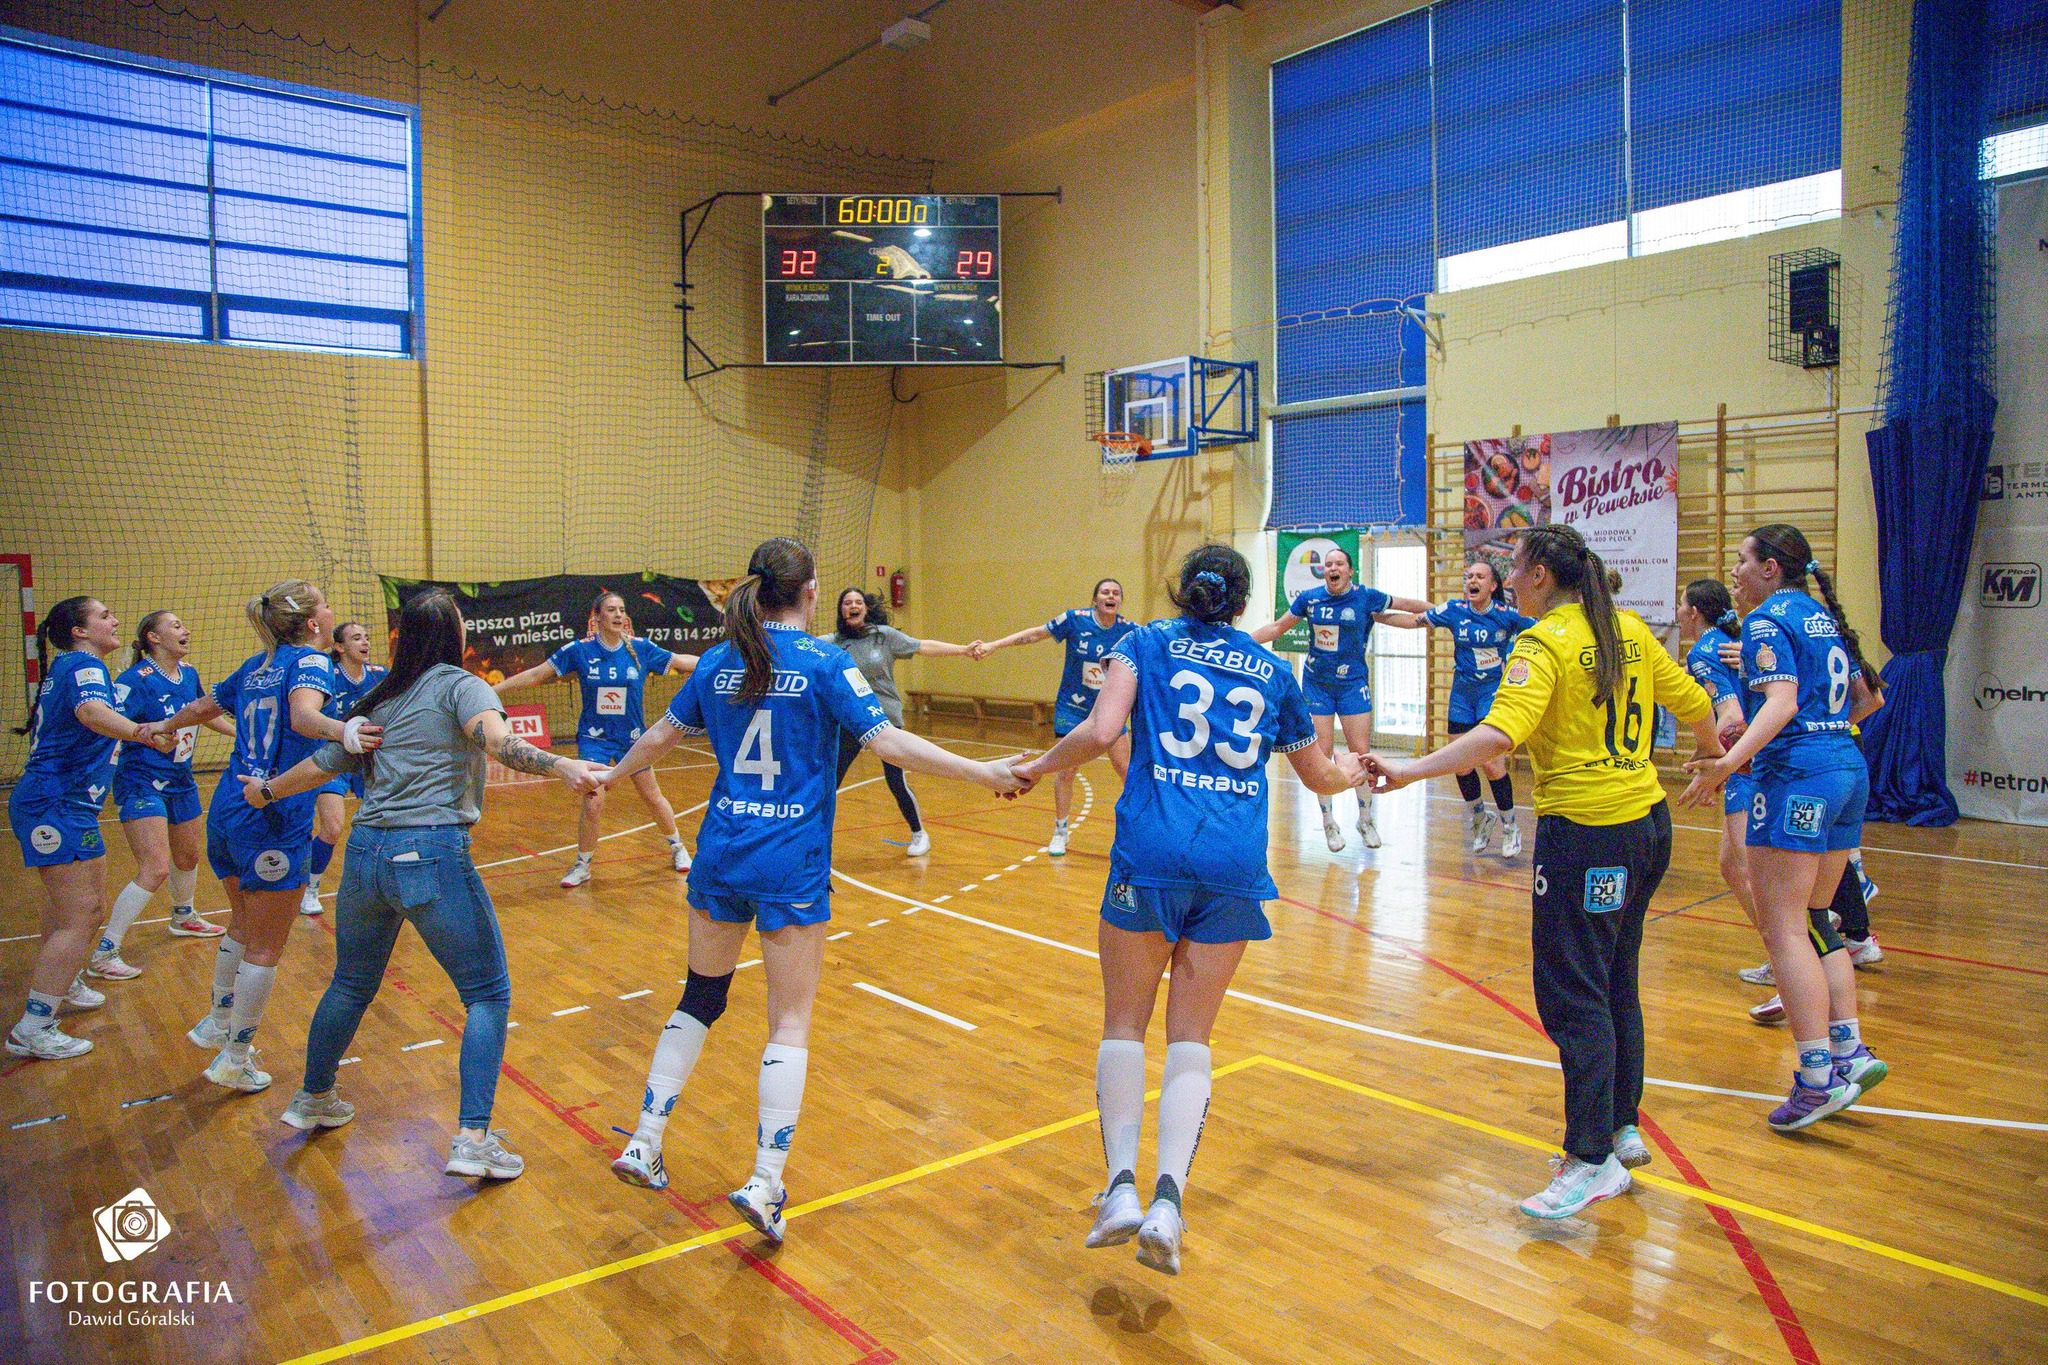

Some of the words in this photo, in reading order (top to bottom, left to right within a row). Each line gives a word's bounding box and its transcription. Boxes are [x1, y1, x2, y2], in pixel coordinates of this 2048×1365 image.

[781, 250, 816, 275] 32
[876, 255, 890, 275] 2
[957, 250, 993, 275] 29
[866, 313, 883, 322] TIME
[885, 313, 901, 322] OUT
[1558, 458, 1666, 508] Bistro
[1564, 510, 1579, 525] w
[1583, 482, 1665, 520] Peweksie
[1594, 529, 1630, 537] MIODOWA
[1604, 558, 1669, 566] KSIE@GMAIL.COM
[1983, 569, 2037, 602] KM
[464, 616, 515, 634] epsza
[519, 611, 561, 630] pizza
[1320, 606, 1334, 619] 12
[493, 634, 508, 647] w
[512, 625, 575, 645] mieście
[646, 628, 670, 640] 737
[674, 628, 698, 640] 814
[702, 626, 726, 640] 299
[1475, 629, 1488, 643] 19
[1096, 645, 1104, 657] 9
[1168, 639, 1275, 680] GERBUD
[609, 667, 617, 680] 5
[713, 673, 809, 693] GEUD
[1827, 645, 1850, 715] 8
[511, 719, 538, 734] EN
[1158, 669, 1266, 770] 33
[1591, 676, 1643, 757] 16
[243, 695, 278, 760] 17
[733, 709, 781, 791] 4
[1168, 768, 1260, 797] TERBUD
[1752, 792, 1767, 820] 8
[1791, 810, 1814, 822] DU
[1792, 801, 1815, 812] MA
[1789, 820, 1812, 831] RO
[1590, 873, 1616, 885] MA
[1590, 884, 1617, 896] DU
[1589, 896, 1615, 907] RO
